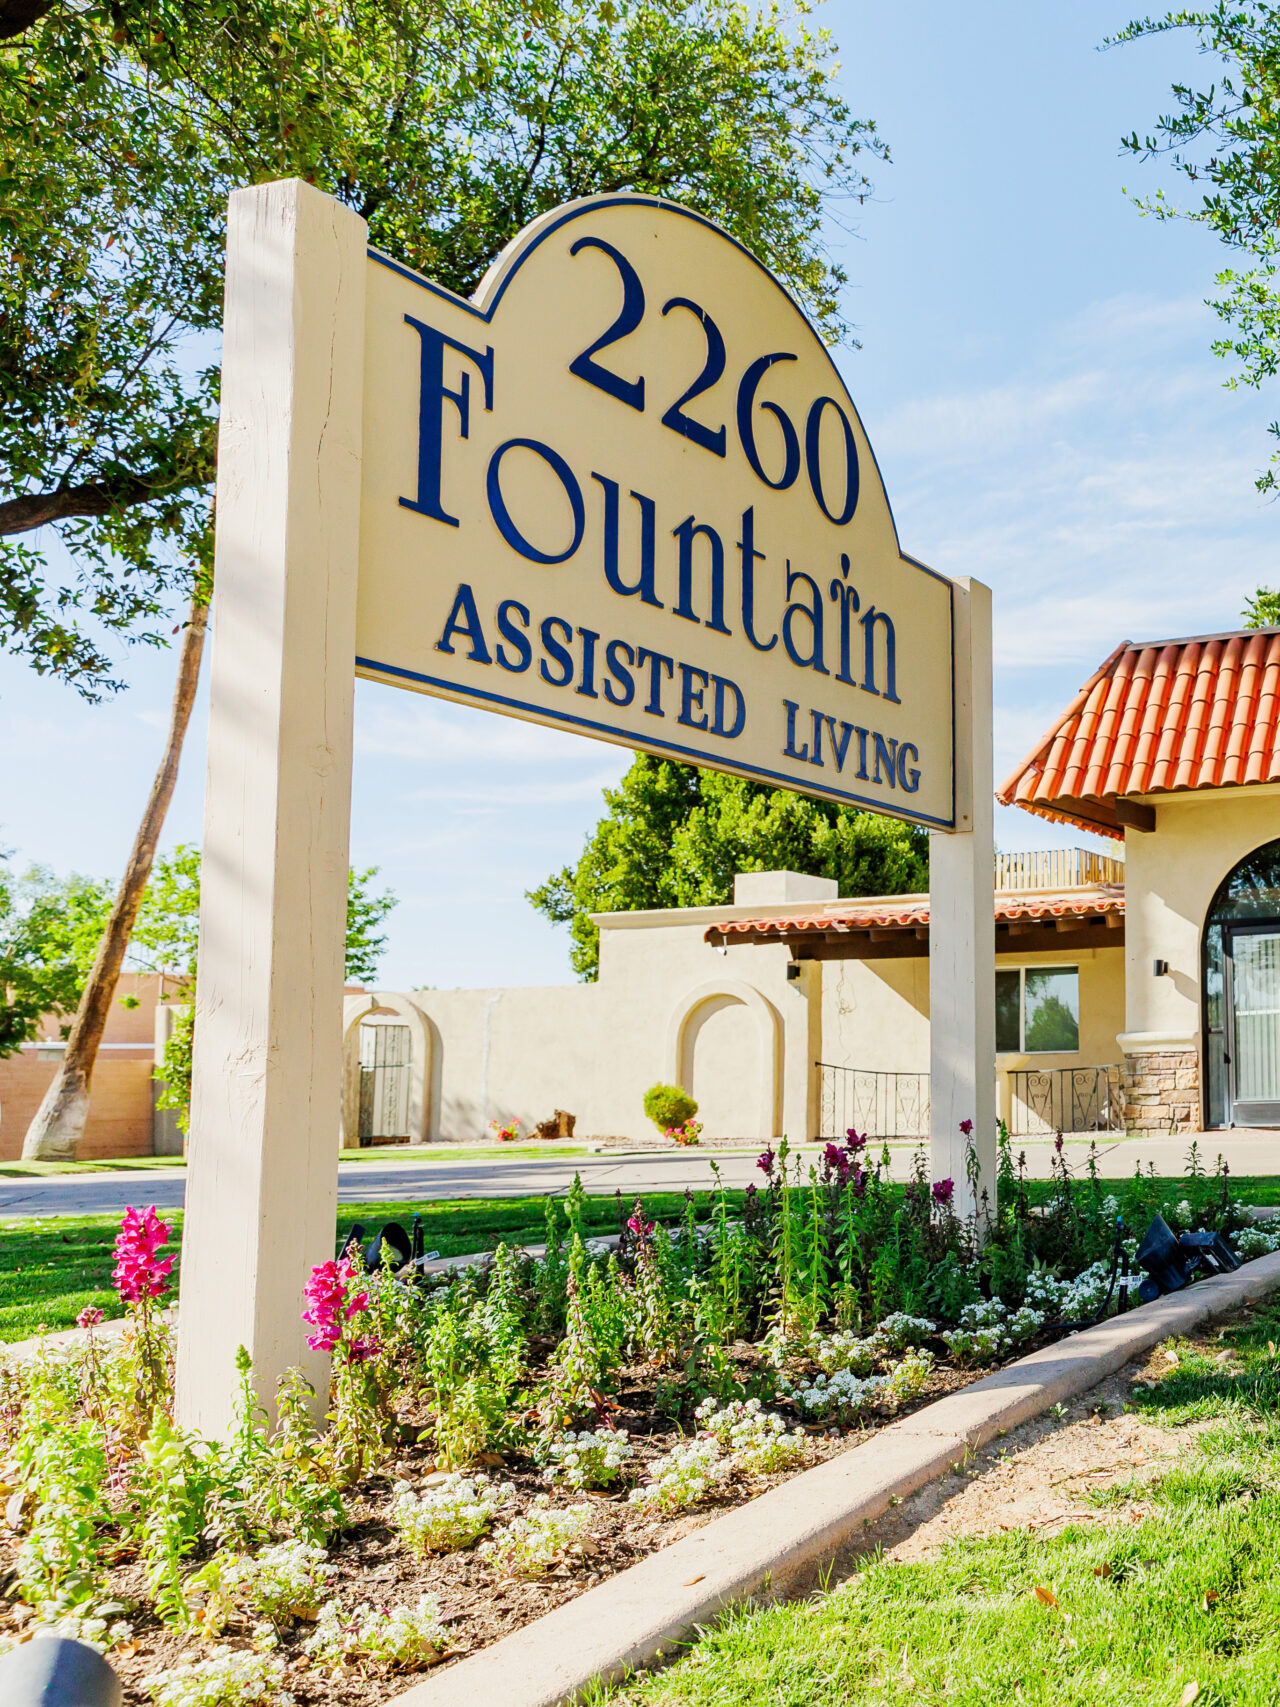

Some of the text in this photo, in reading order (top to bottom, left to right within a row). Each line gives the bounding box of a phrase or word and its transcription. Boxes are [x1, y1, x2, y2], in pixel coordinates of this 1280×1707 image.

[399, 313, 901, 705] Fountain
[569, 236, 860, 525] 2260
[436, 583, 921, 794] ASSISTED LIVING
